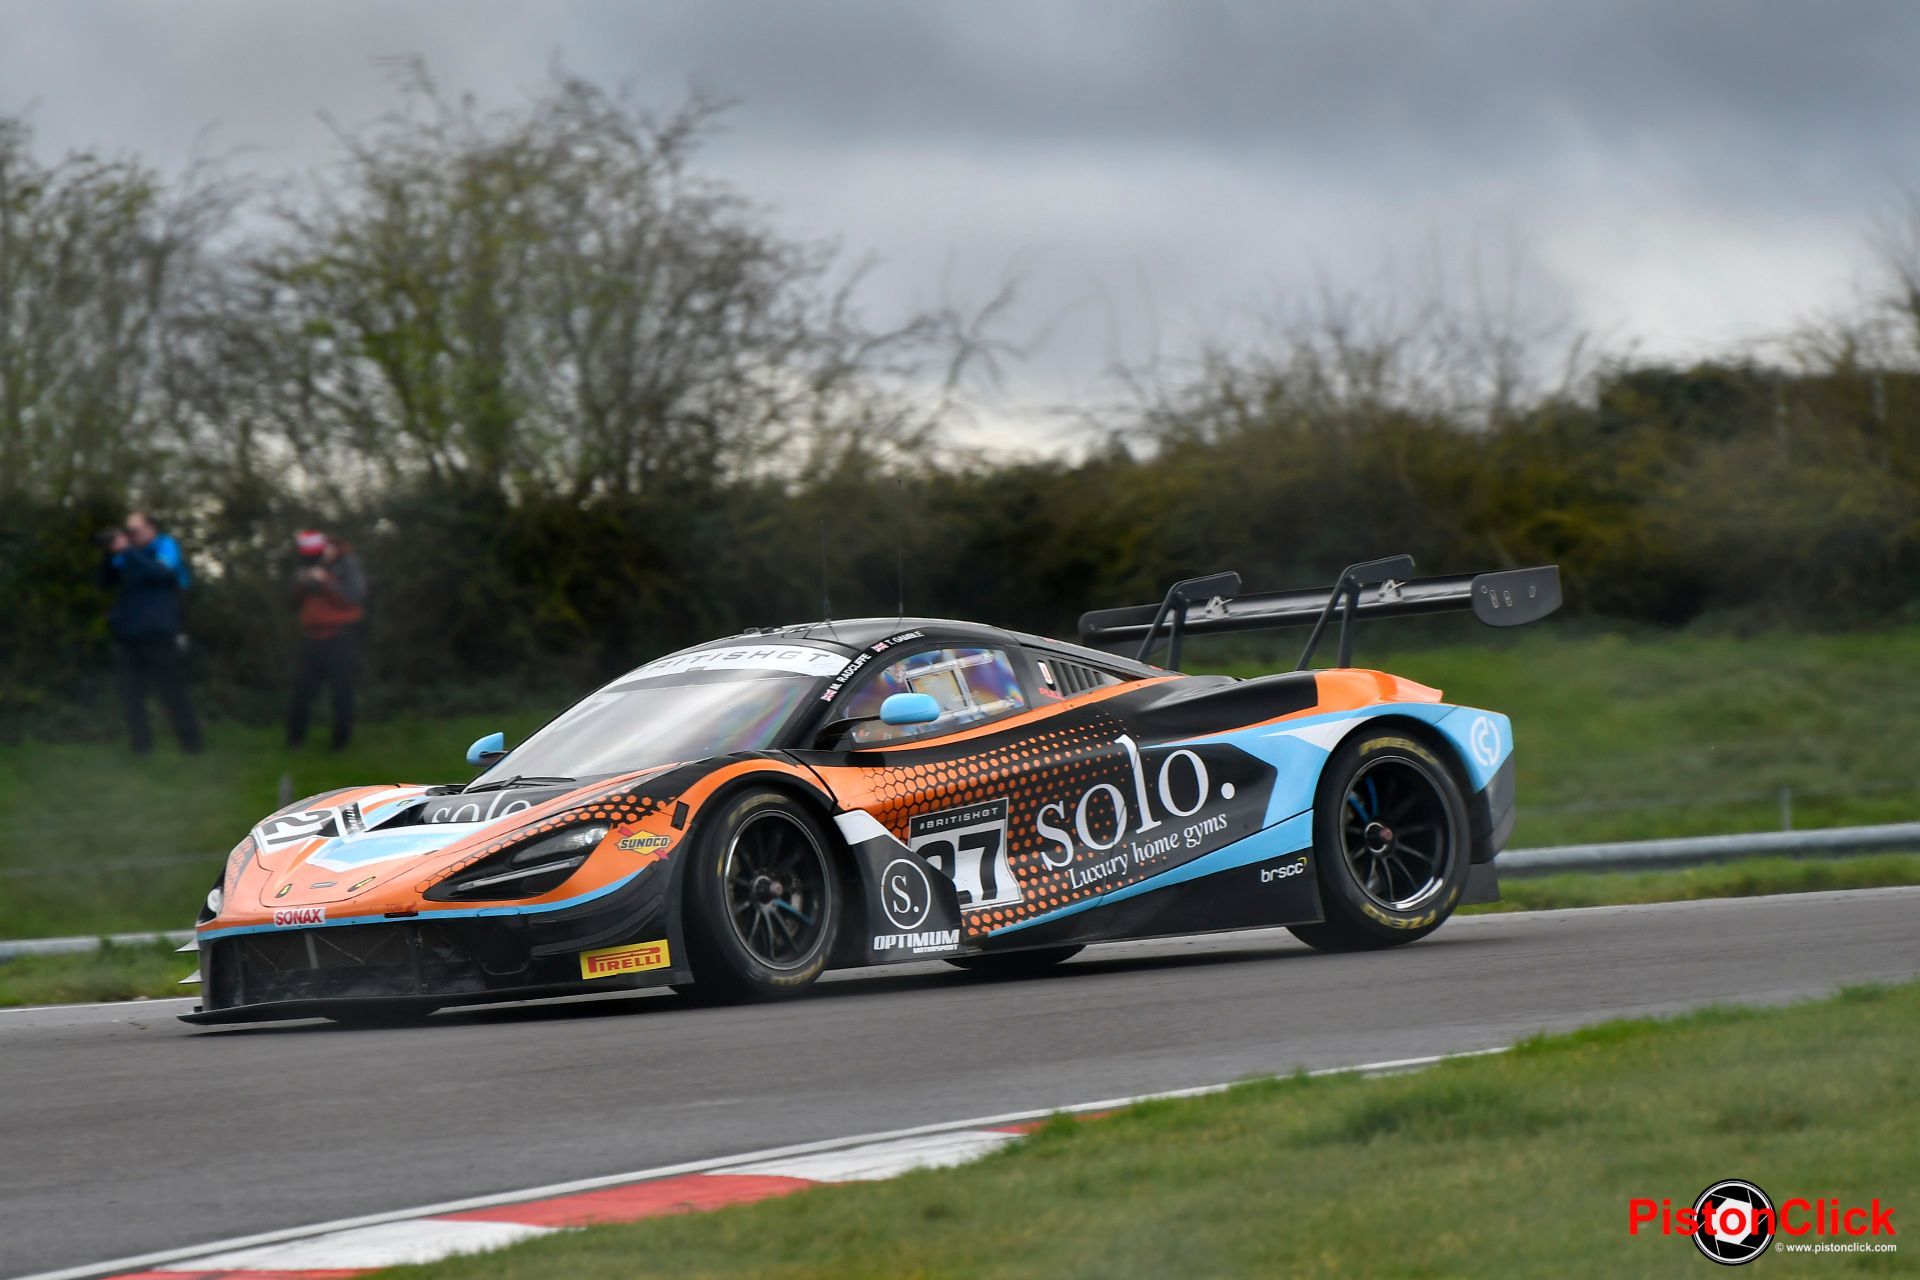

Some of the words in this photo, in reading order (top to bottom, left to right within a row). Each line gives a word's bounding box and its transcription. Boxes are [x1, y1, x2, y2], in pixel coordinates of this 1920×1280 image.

[893, 630, 925, 643] GAMBLE
[836, 652, 872, 683] RADCLIFFE
[1036, 734, 1236, 872] solo.
[920, 807, 999, 829] #BRITISHGT
[620, 837, 668, 849] SUNOCO
[1068, 853, 1129, 889] Luxury
[1131, 832, 1181, 864] home
[1183, 813, 1228, 847] gyms
[1261, 862, 1304, 883] brscc
[275, 909, 321, 926] SONAX
[873, 929, 960, 951] OPTIMUM
[587, 946, 662, 974] PIRELLI
